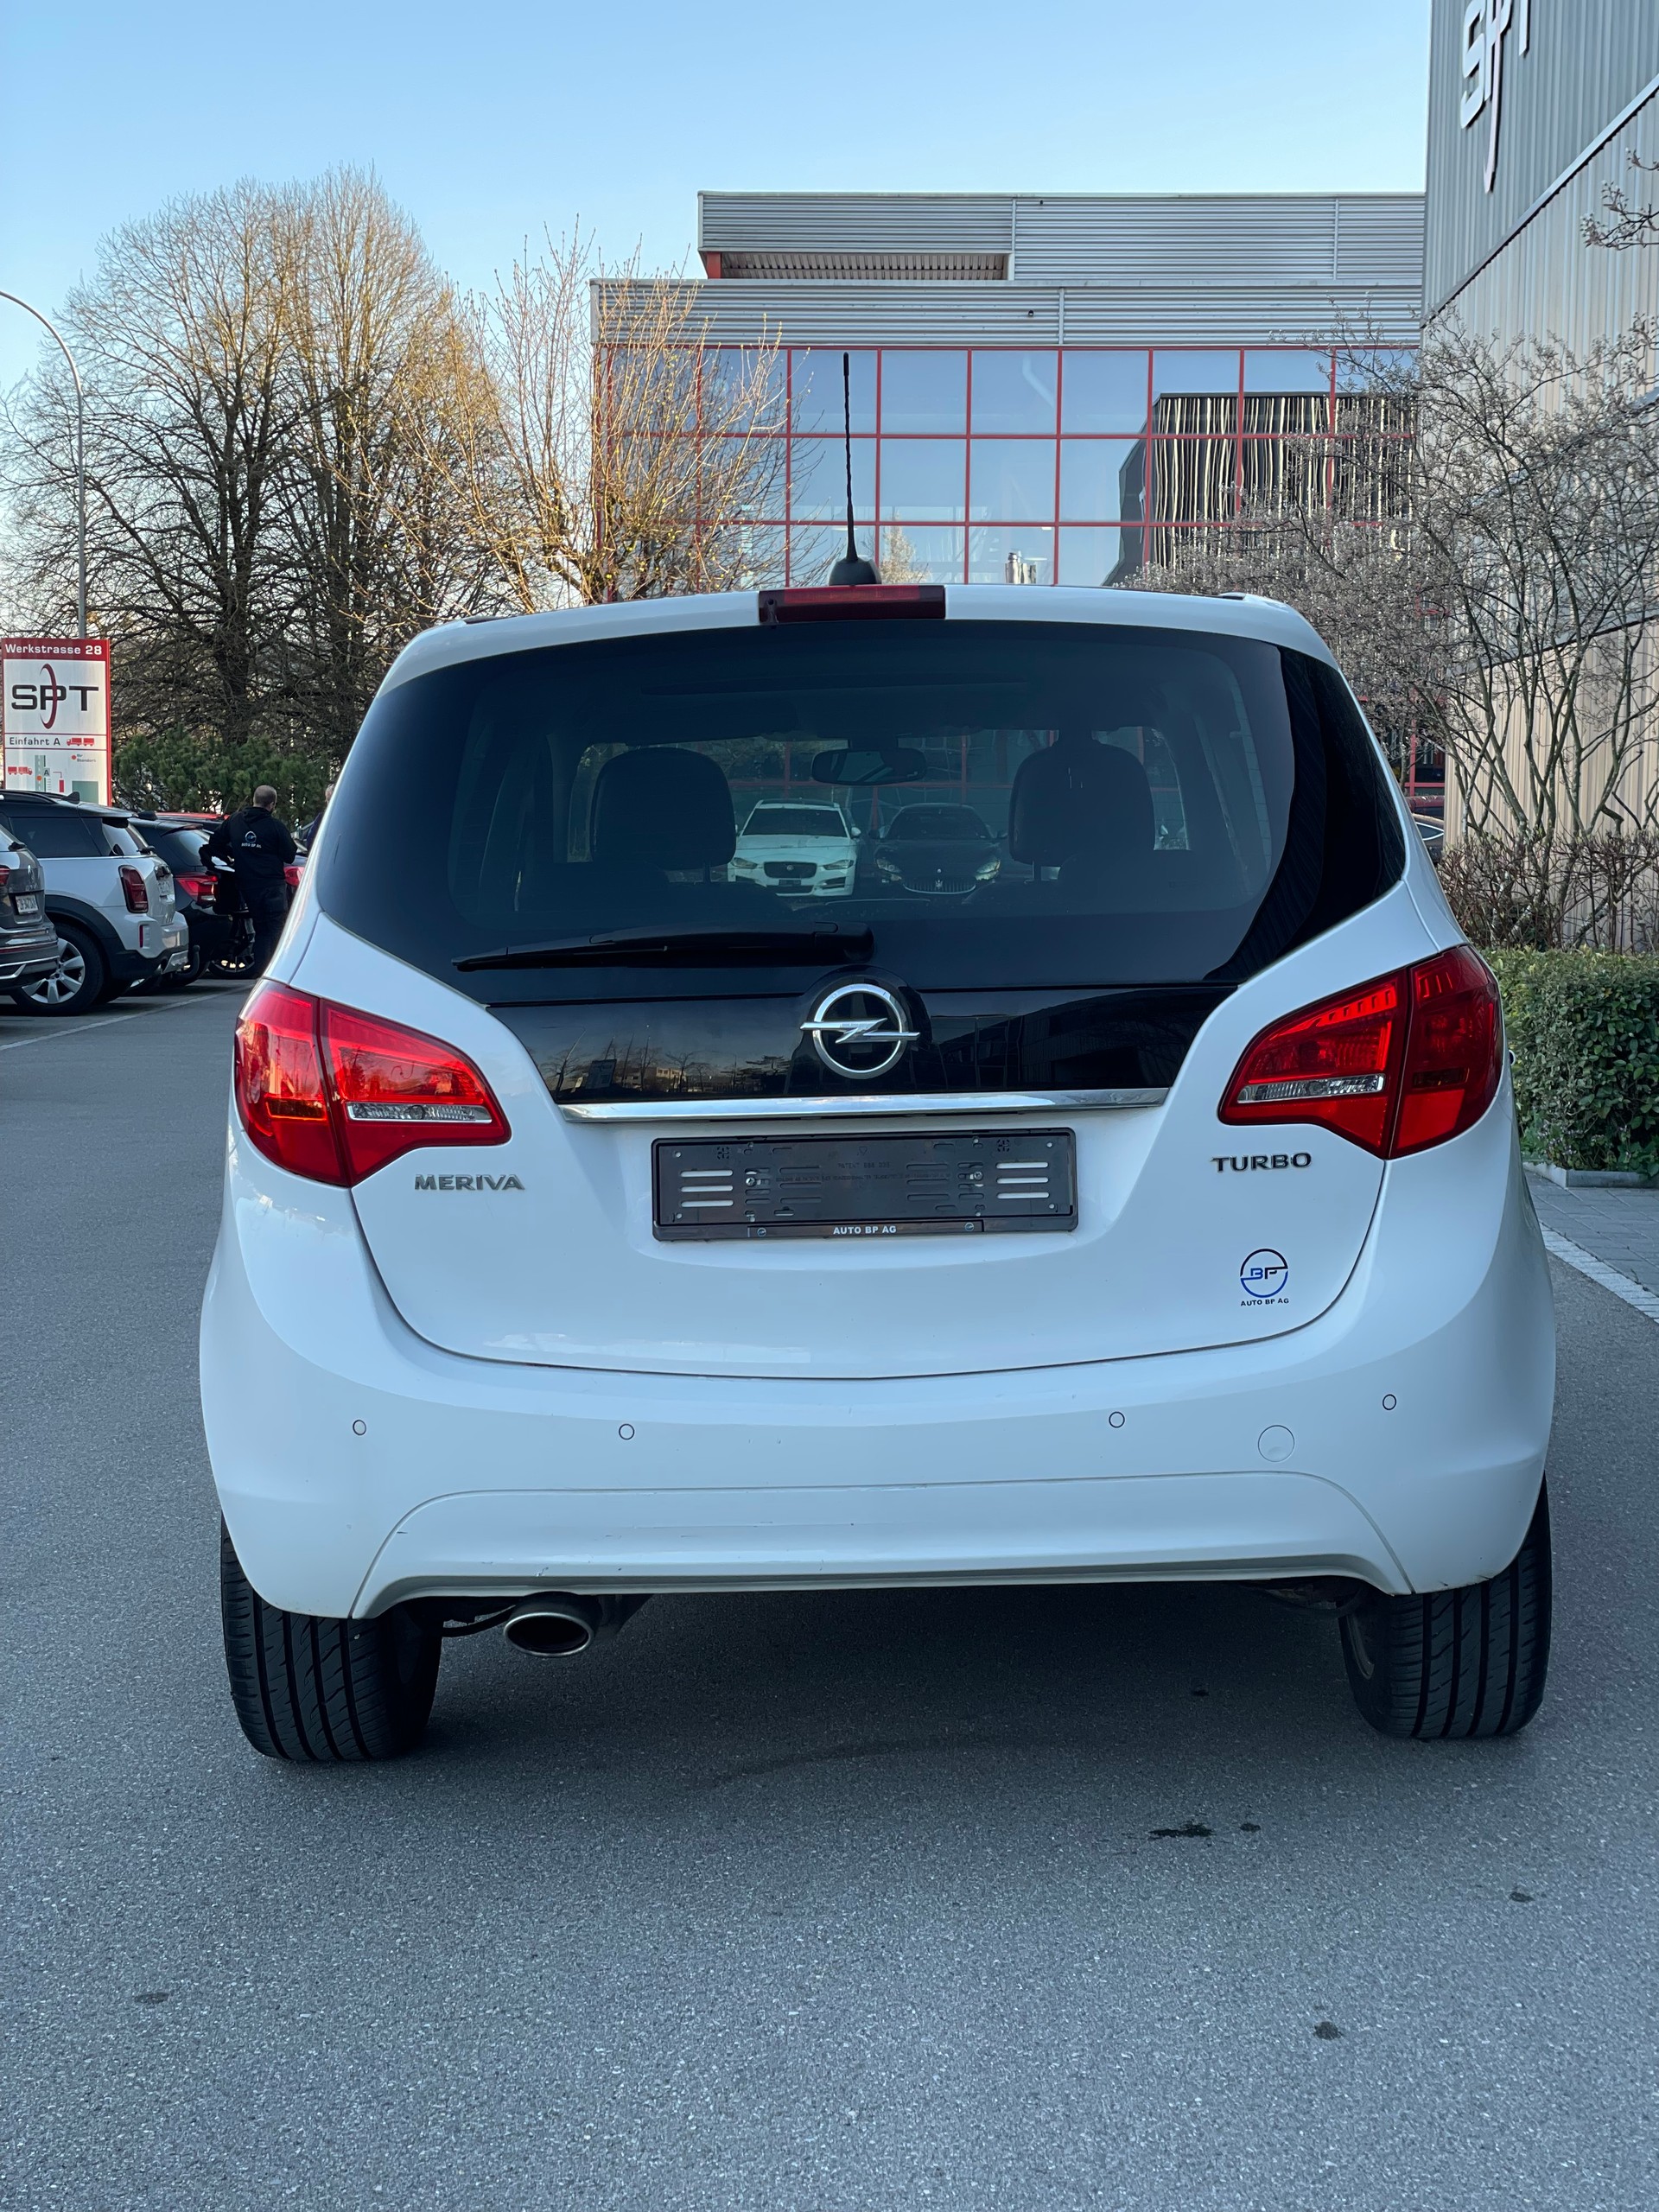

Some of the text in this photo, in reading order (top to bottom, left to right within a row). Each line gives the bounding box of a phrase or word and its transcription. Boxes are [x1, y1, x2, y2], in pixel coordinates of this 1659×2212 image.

[5, 644, 102, 655] Werkstrasse 28
[11, 684, 99, 711] SPT
[1211, 1152, 1312, 1173] TURBO
[415, 1174, 525, 1190] MERIVA
[865, 1225, 879, 1234] BP
[882, 1225, 897, 1234] AG
